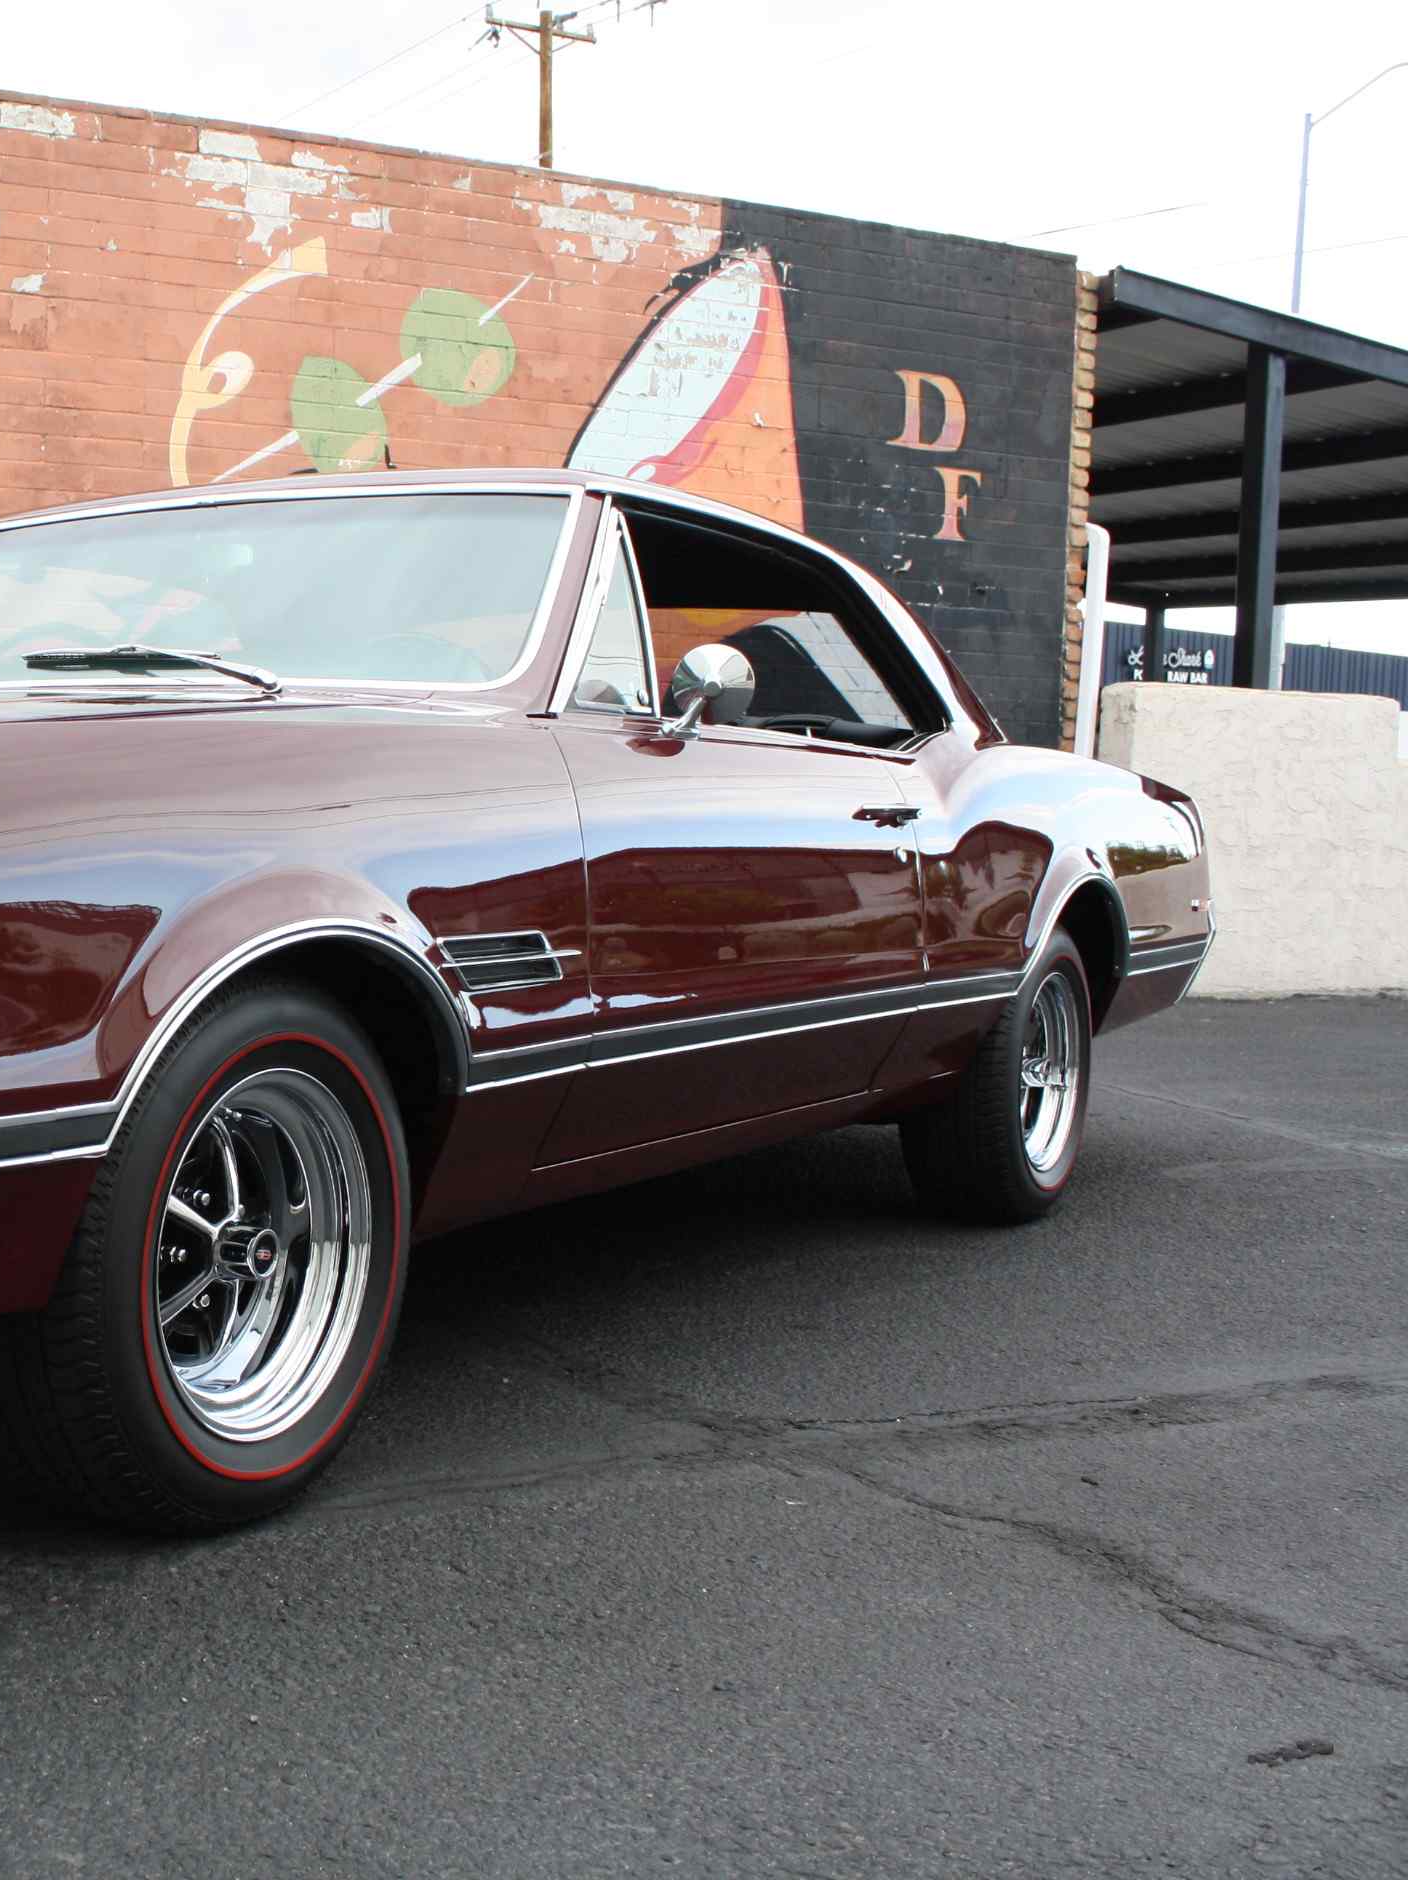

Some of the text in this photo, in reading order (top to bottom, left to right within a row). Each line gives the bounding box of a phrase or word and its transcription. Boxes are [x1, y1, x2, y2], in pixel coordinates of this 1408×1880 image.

[886, 369, 966, 452] D
[933, 466, 982, 542] F
[1167, 671, 1208, 684] RAW BAR
